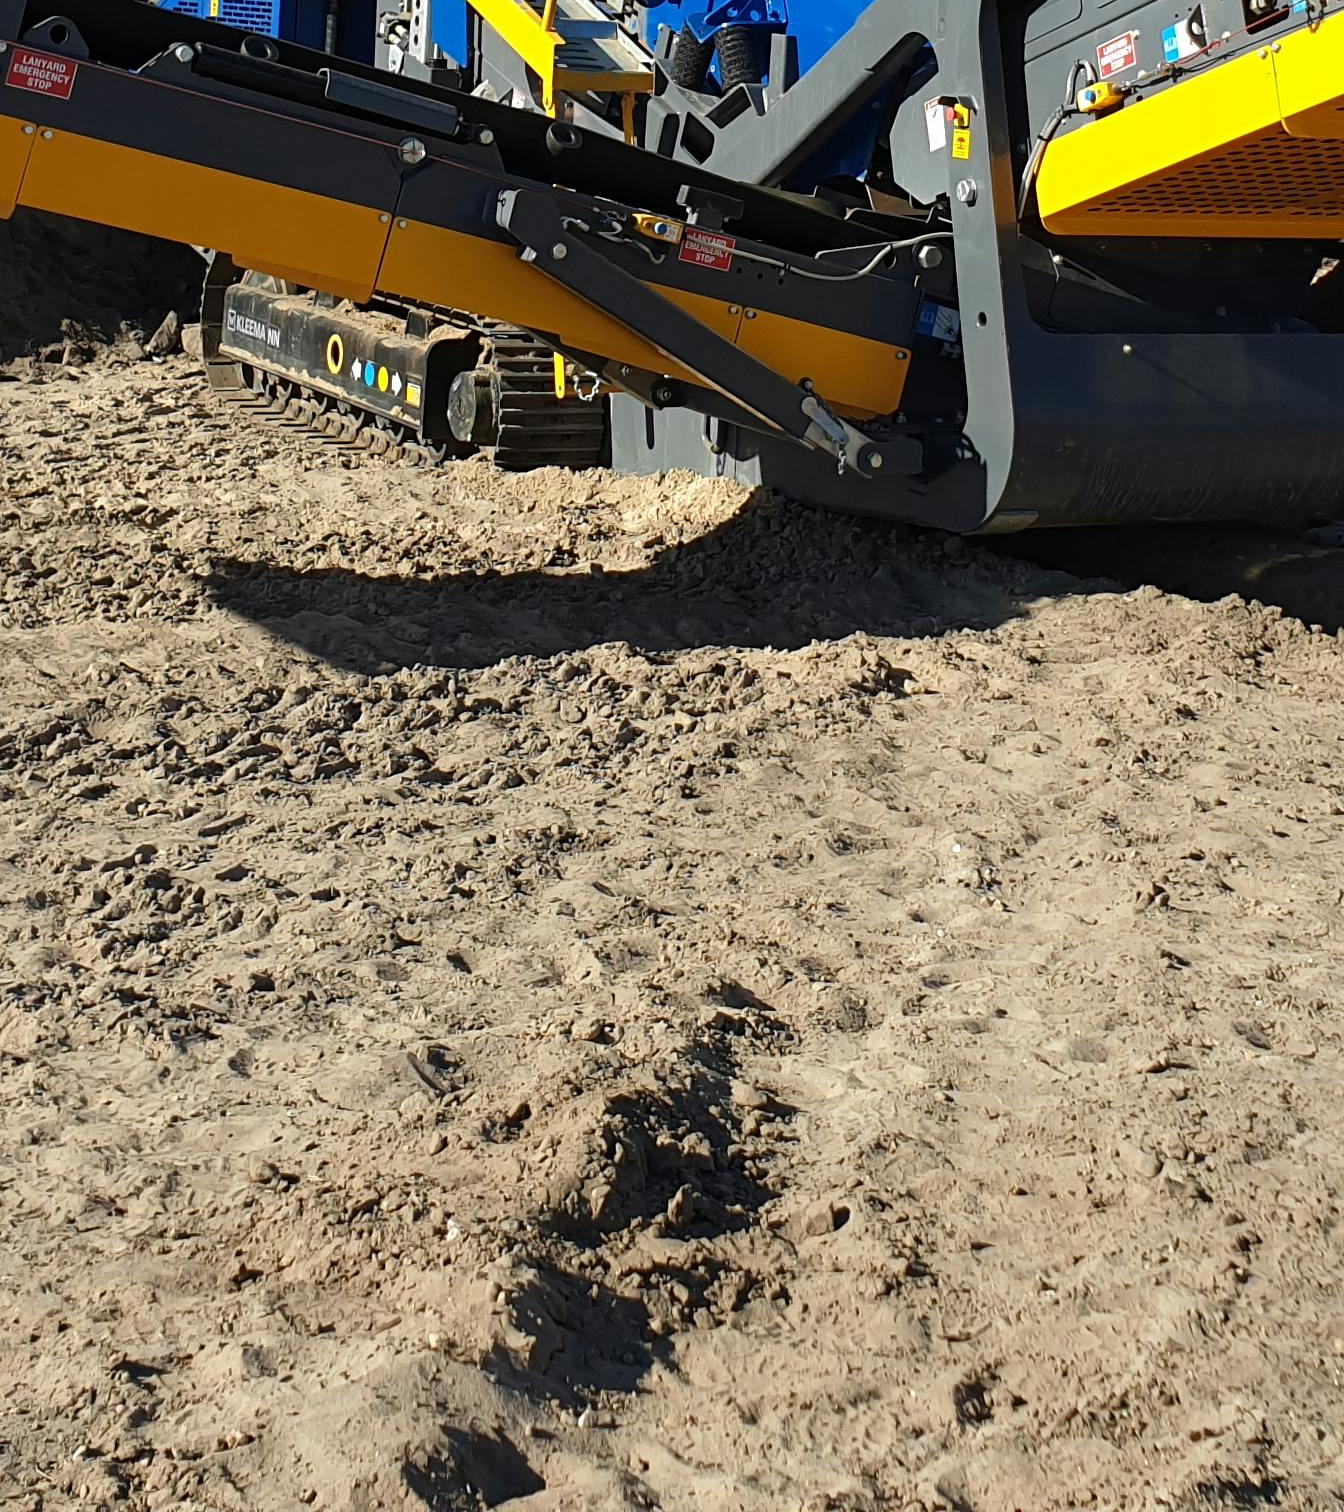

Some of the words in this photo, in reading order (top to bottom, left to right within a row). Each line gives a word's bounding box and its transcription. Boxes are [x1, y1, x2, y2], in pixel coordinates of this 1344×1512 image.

[22, 54, 66, 73] LANYARD
[13, 63, 71, 85] EMERGENCY
[26, 77, 53, 90] STOP
[695, 252, 716, 264] STOP
